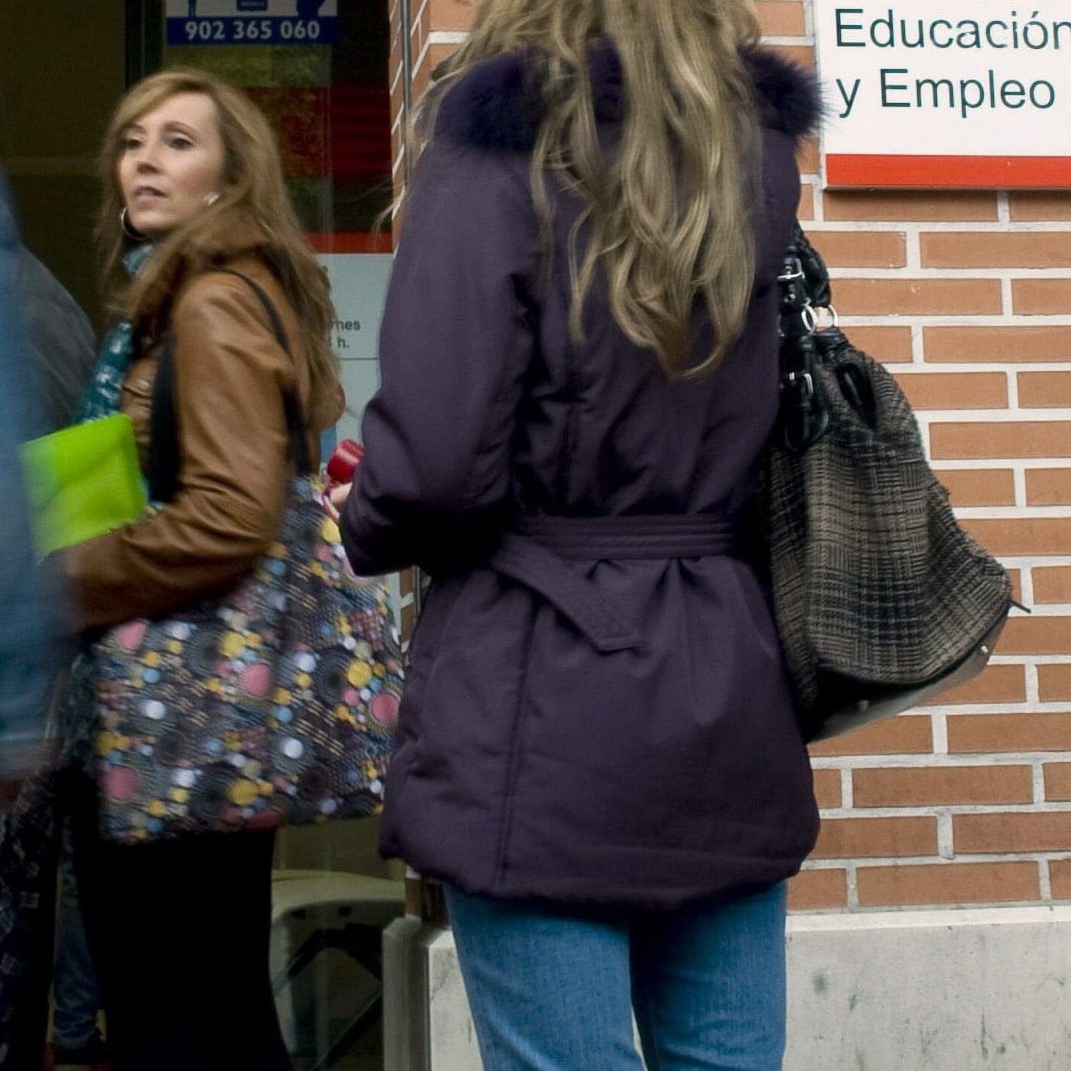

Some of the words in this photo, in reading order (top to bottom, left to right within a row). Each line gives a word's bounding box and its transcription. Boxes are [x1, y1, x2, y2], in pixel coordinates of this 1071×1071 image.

[184, 20, 226, 40] 902
[232, 20, 272, 40] 365
[280, 20, 320, 39] 060
[835, 8, 1071, 50] Educación
[835, 78, 861, 119] y
[879, 68, 1055, 119] Empleo
